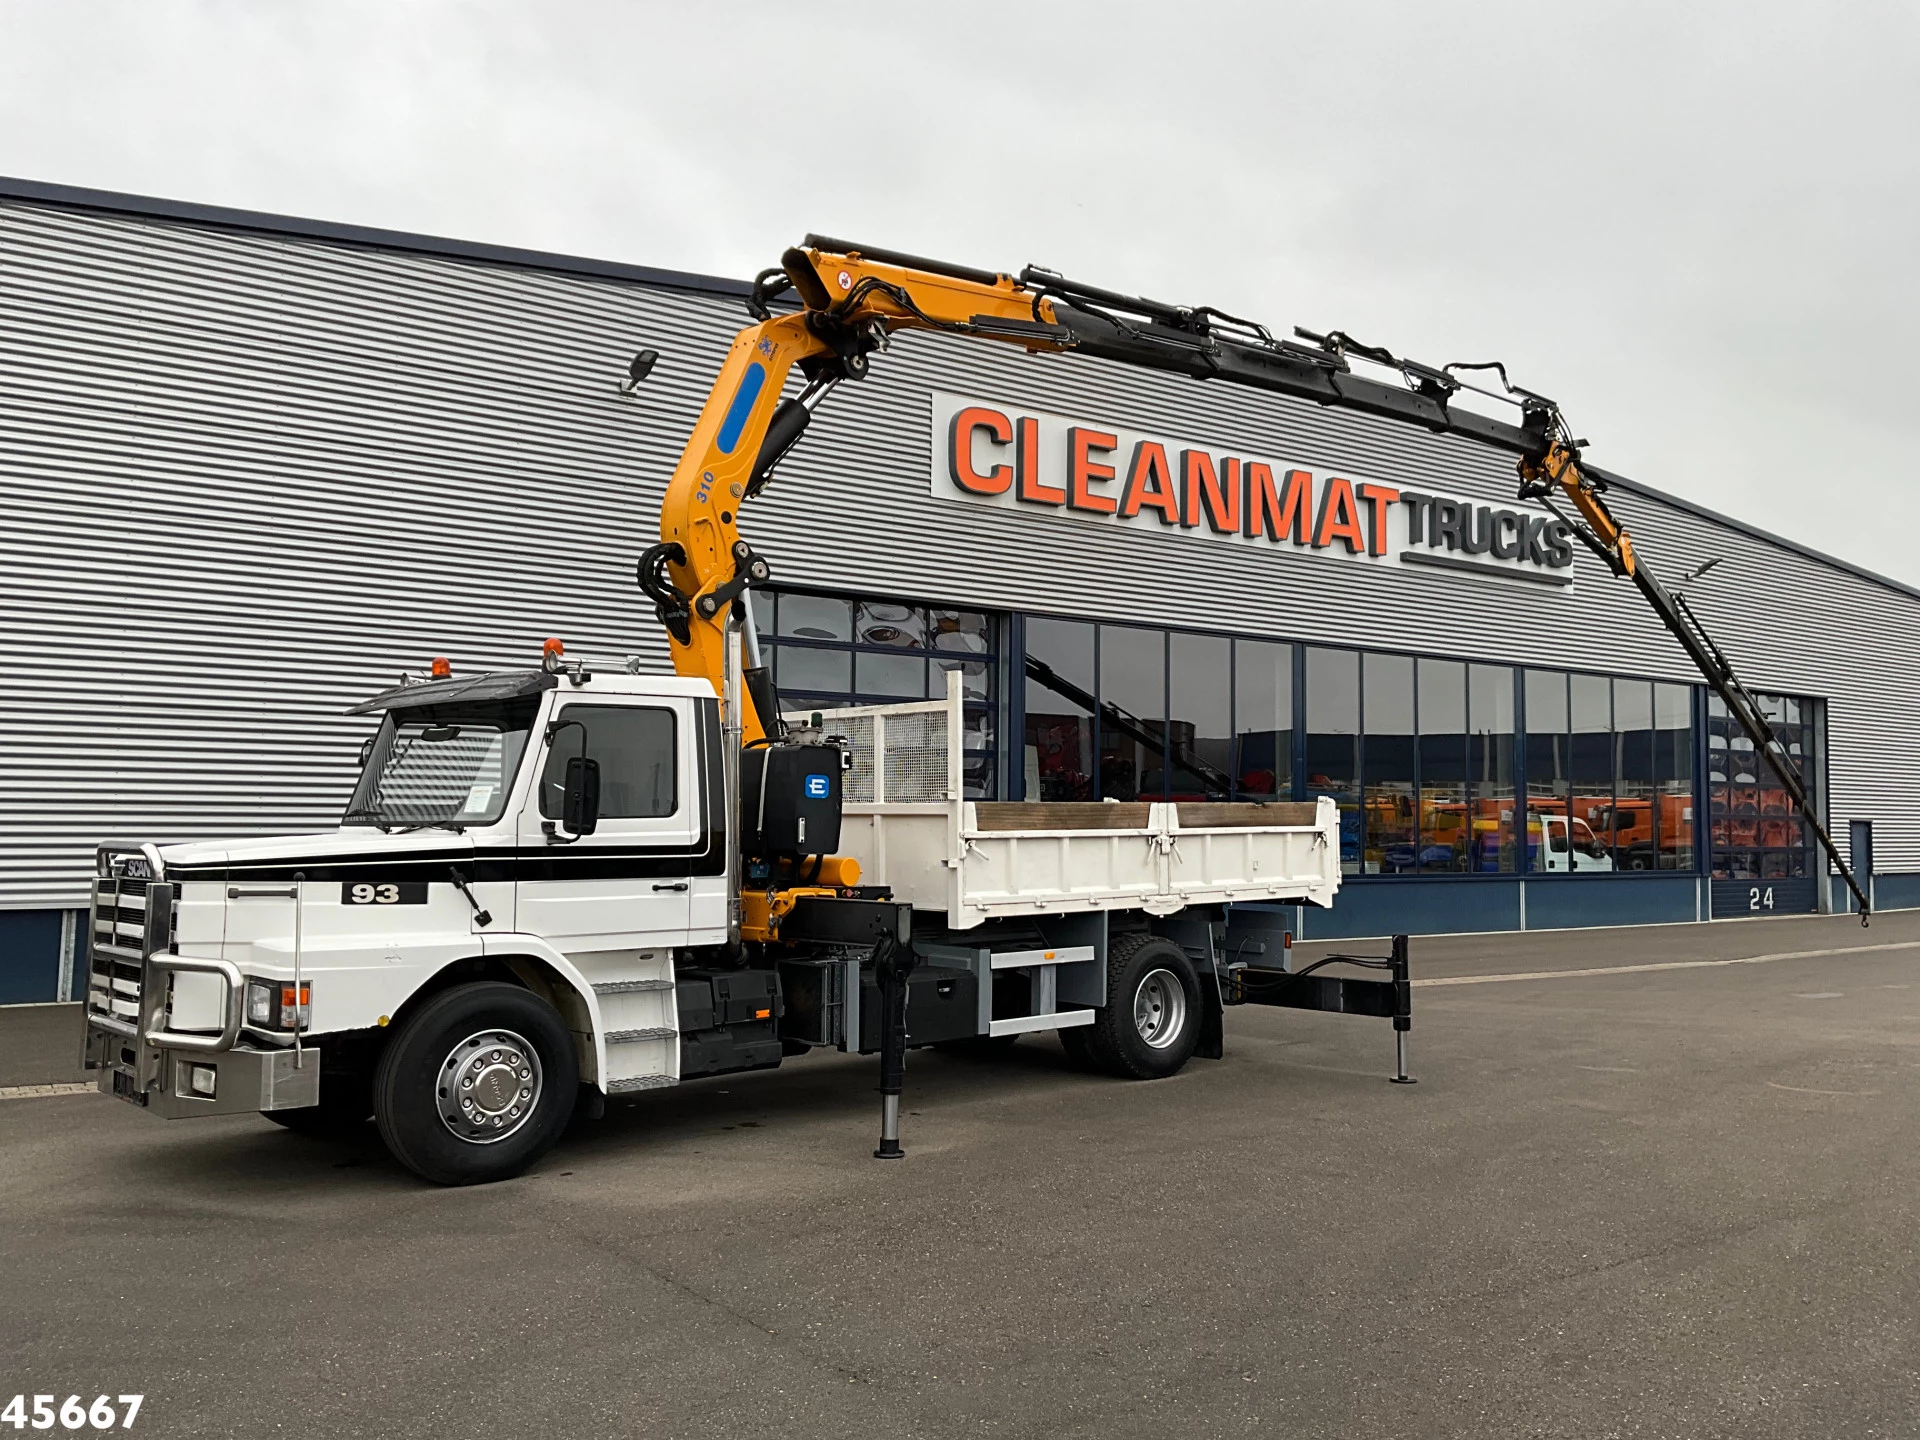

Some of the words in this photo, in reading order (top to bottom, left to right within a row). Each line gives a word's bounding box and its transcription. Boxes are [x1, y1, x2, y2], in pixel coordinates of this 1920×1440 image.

[696, 471, 714, 504] 310
[948, 406, 1399, 557] CLEANMAT
[1400, 491, 1573, 568] TRUCKS
[127, 860, 152, 878] SCAN
[351, 883, 400, 904] 93
[1749, 887, 1774, 910] 24
